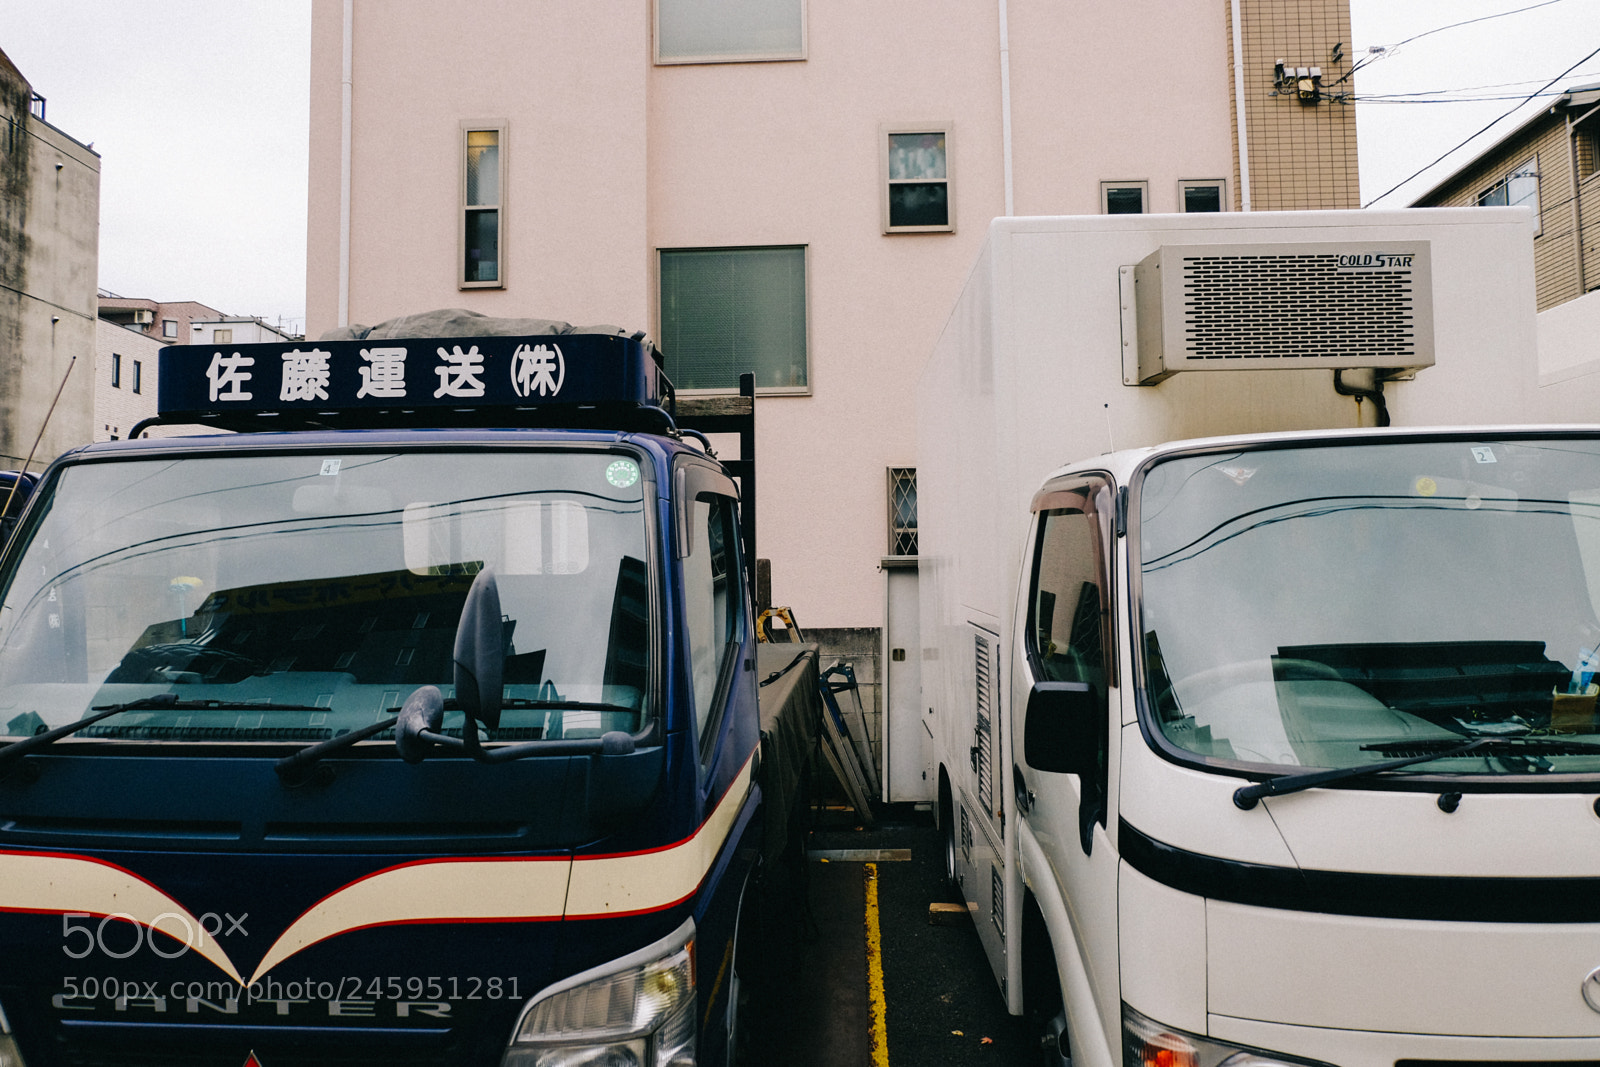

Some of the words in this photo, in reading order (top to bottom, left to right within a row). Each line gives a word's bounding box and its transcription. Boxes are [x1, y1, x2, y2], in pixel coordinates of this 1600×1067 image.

[1339, 254, 1372, 266] COLD
[1375, 254, 1415, 267] STAR
[52, 993, 452, 1018] CANTER
